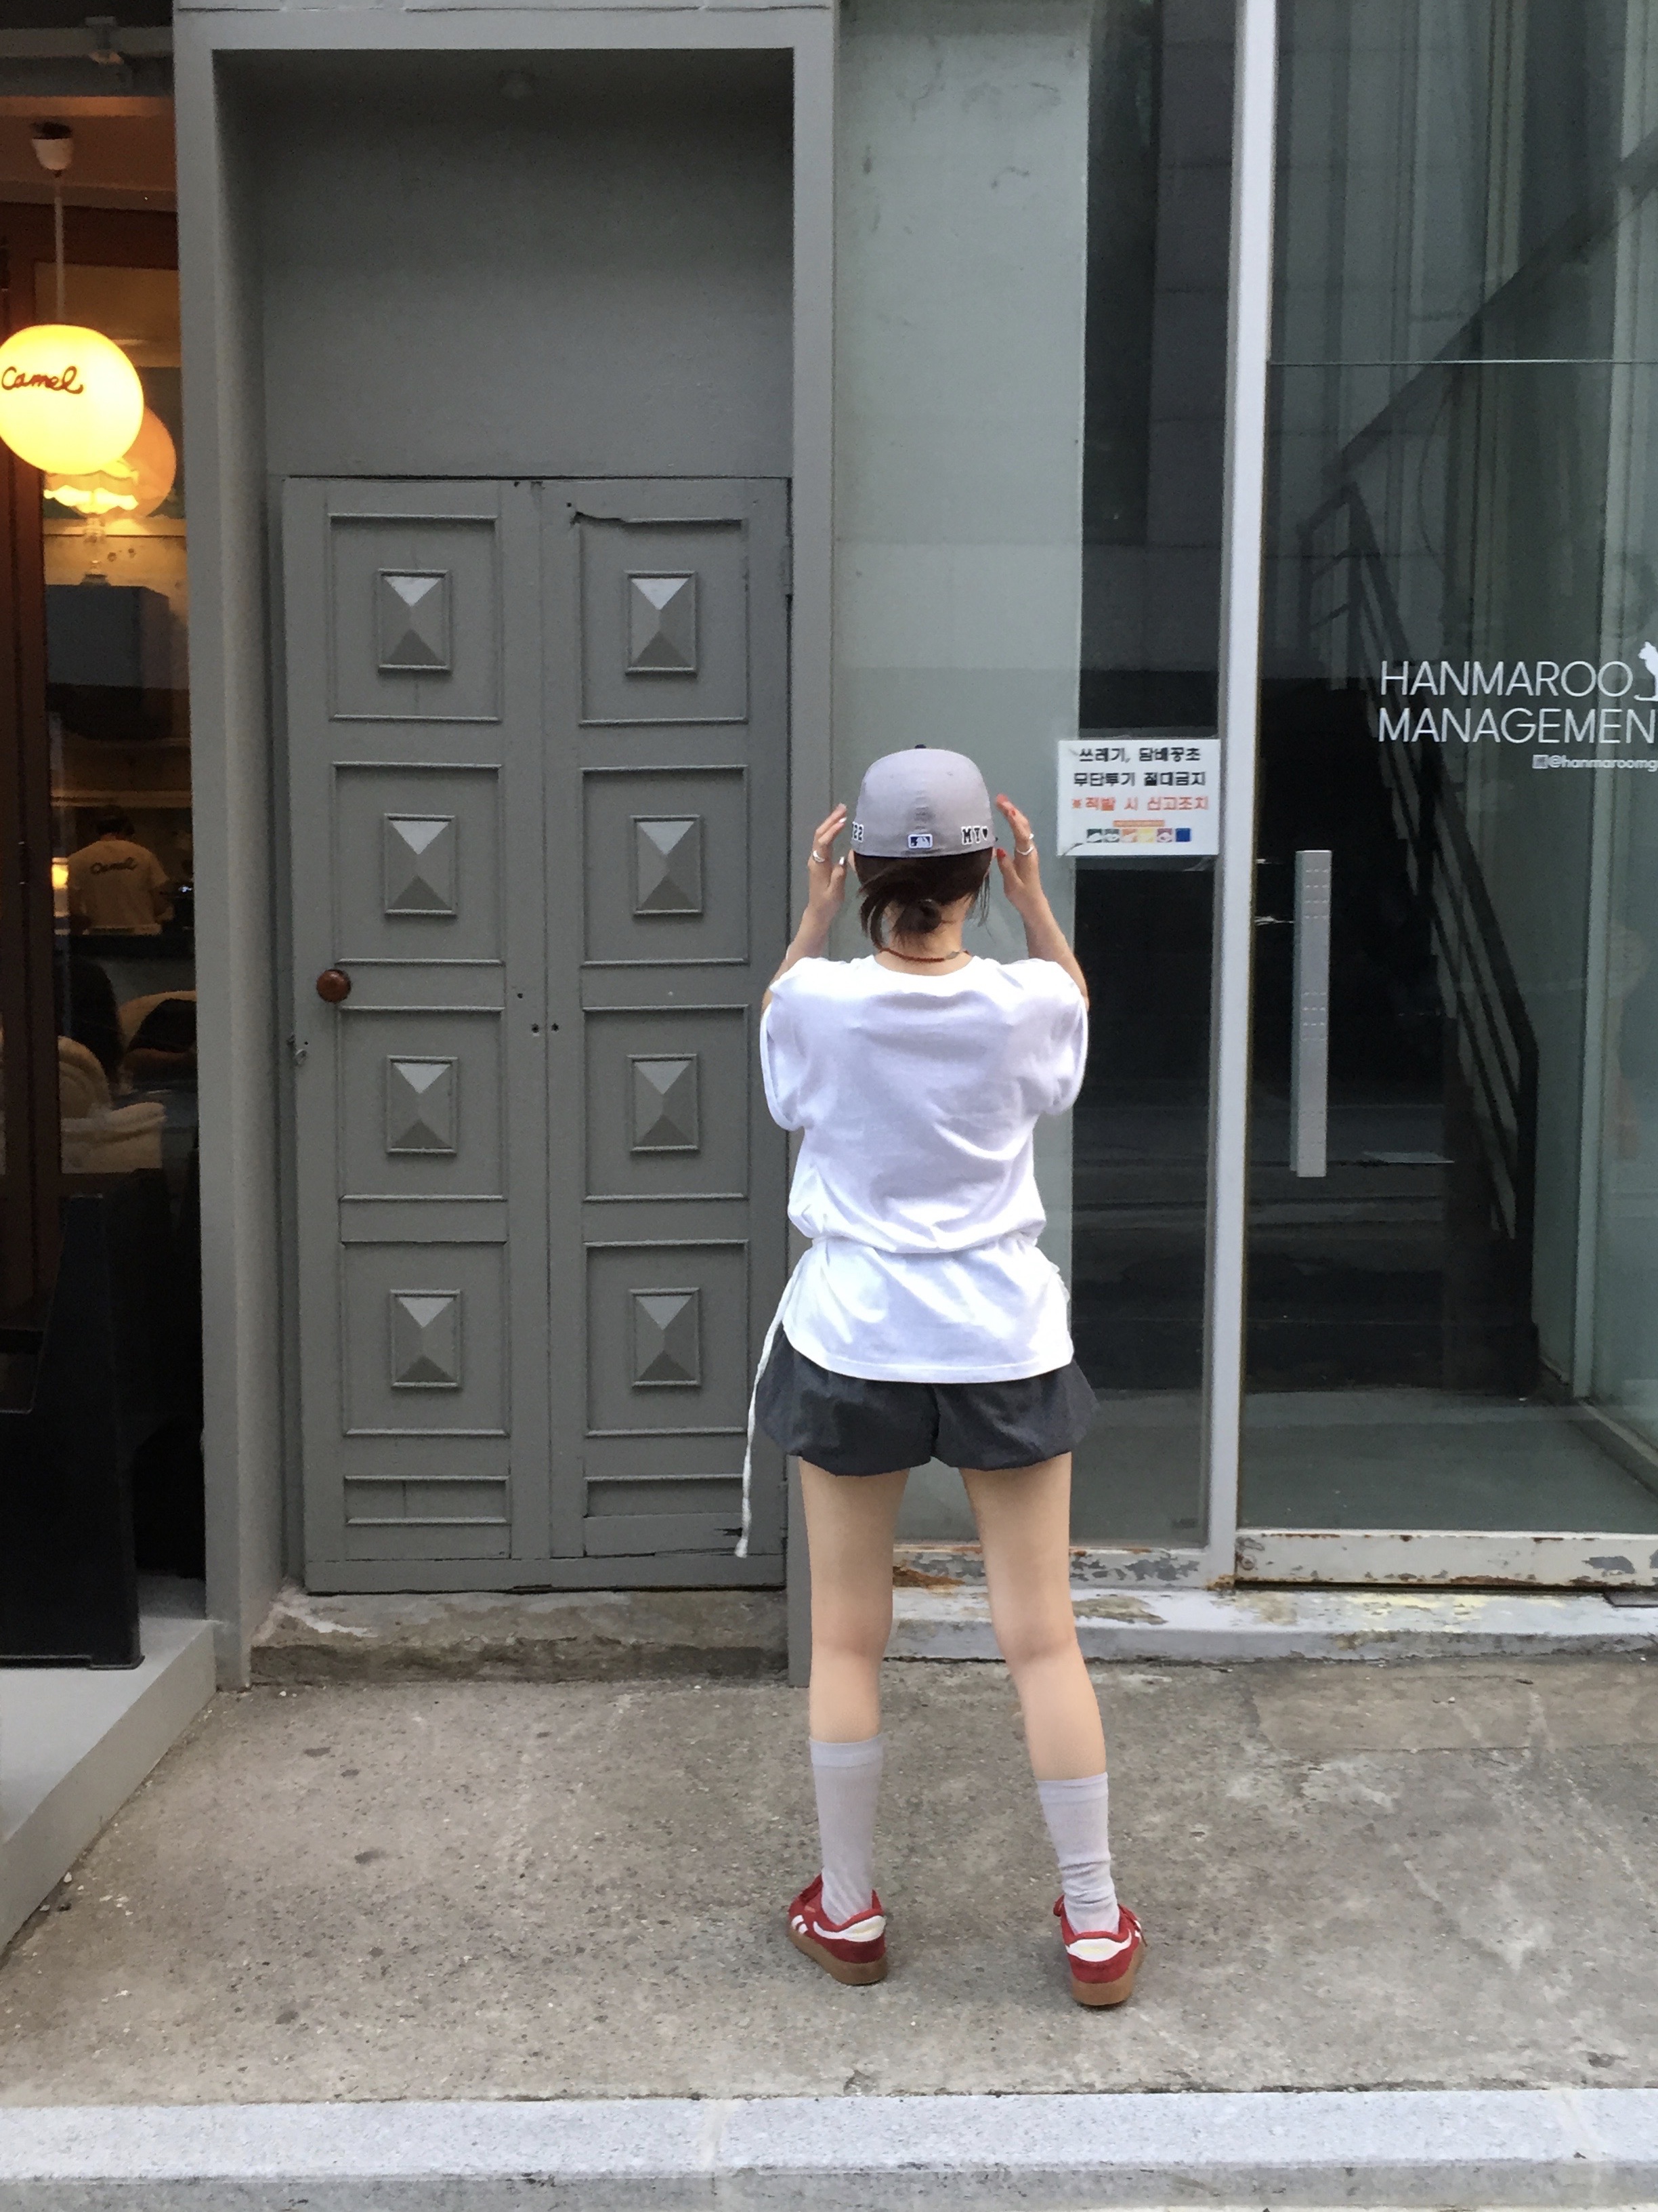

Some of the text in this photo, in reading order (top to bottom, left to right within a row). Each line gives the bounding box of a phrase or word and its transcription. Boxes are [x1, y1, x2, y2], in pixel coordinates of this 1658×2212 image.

[1, 365, 84, 394] Camel
[1380, 661, 1634, 697] HANMAROO
[1378, 707, 1655, 744] MANAGEMEN
[1074, 771, 1206, 787] 무단투기 절대금지
[1124, 797, 1139, 811] 시
[1147, 796, 1209, 811] 신고조치
